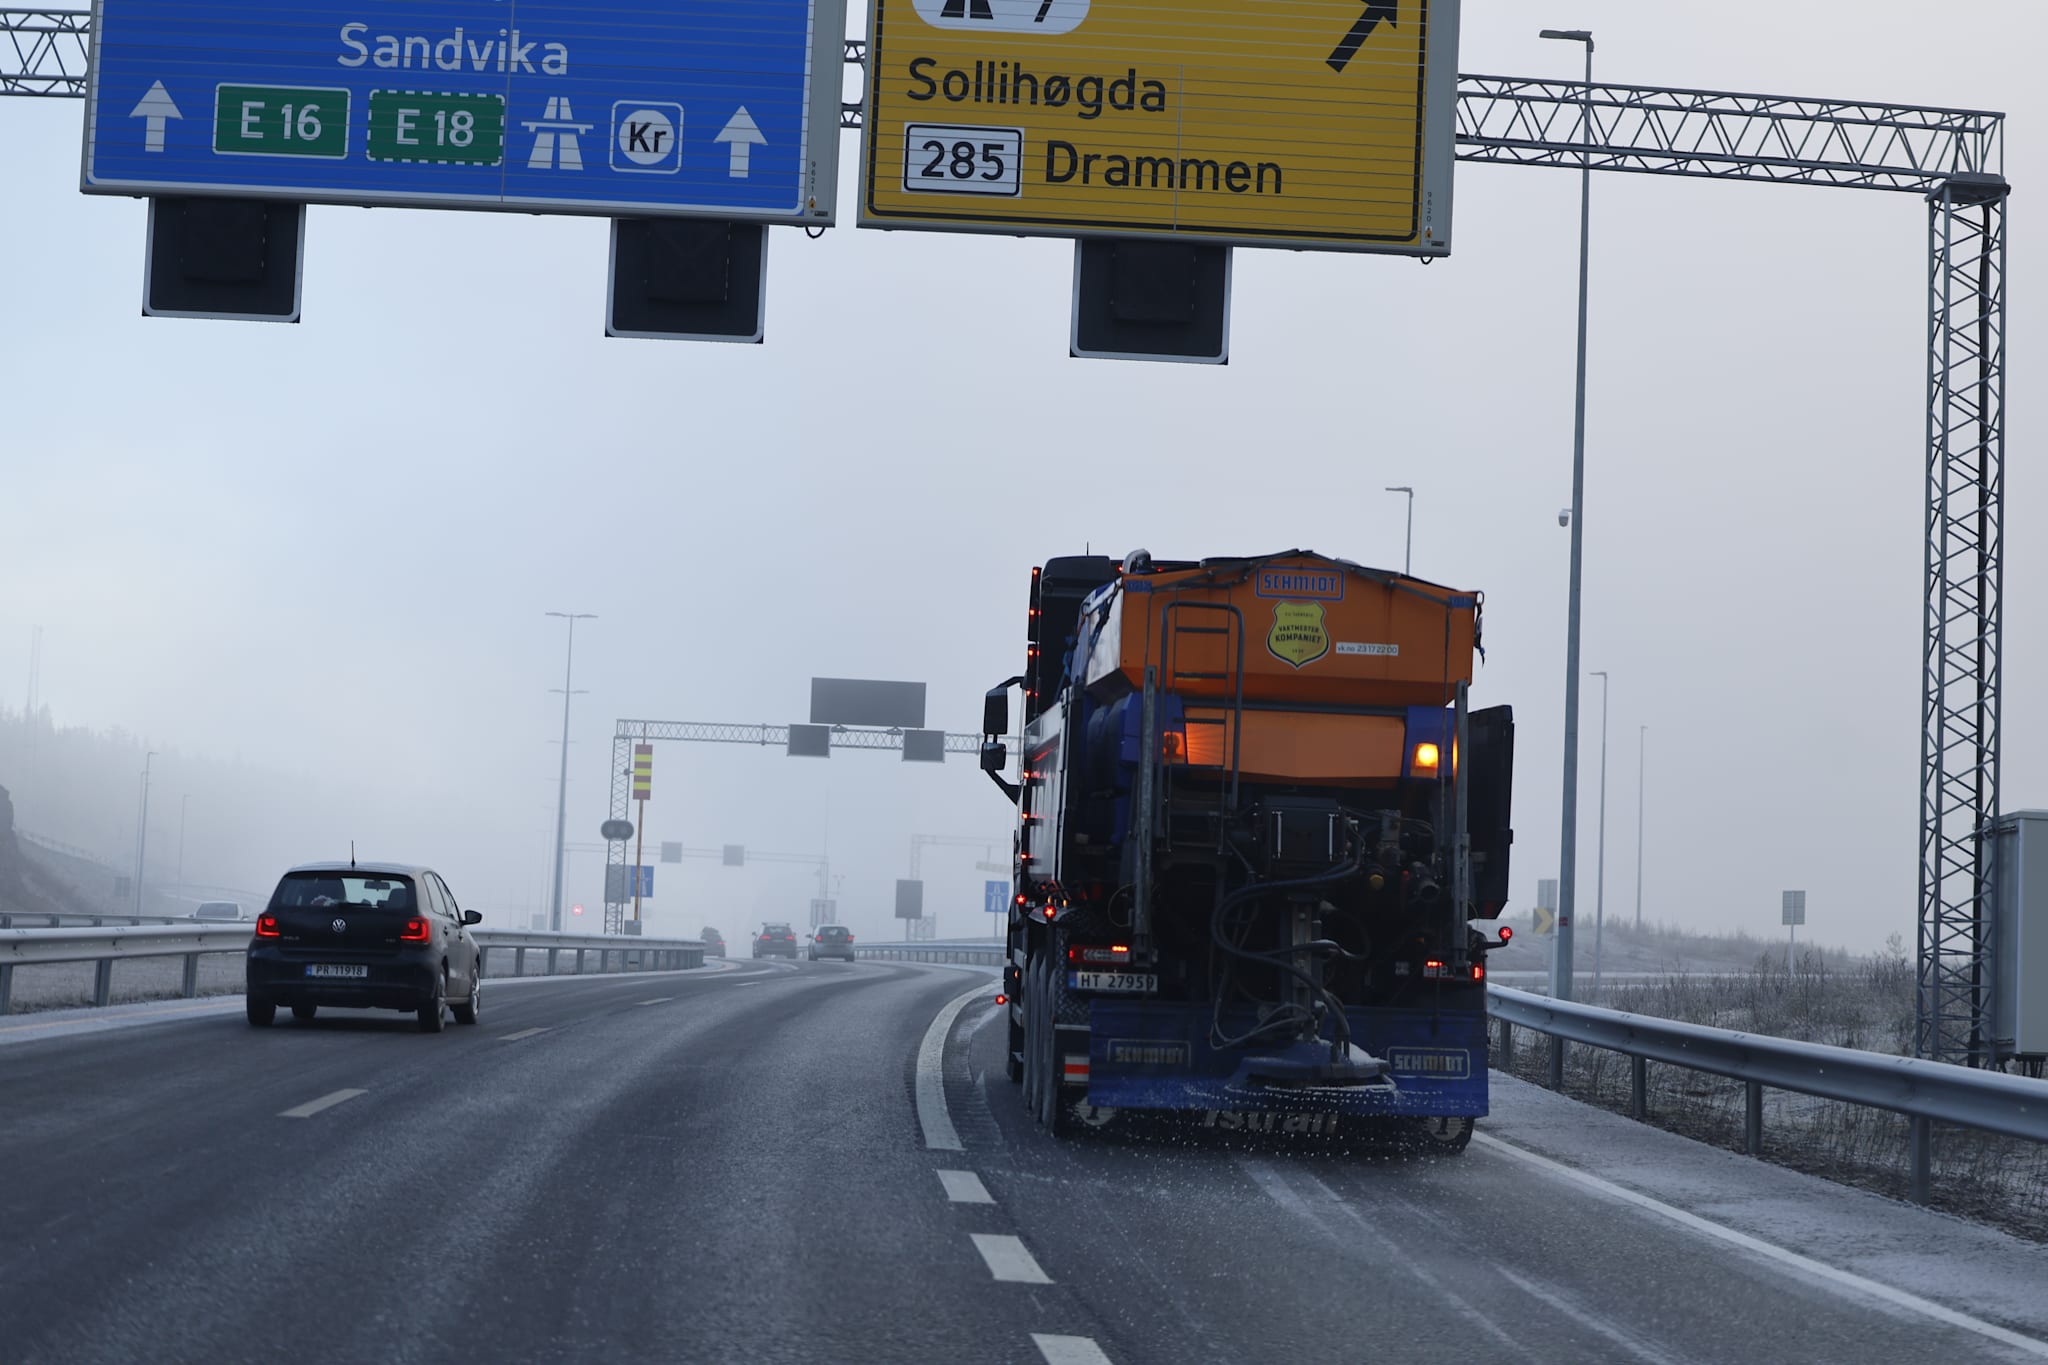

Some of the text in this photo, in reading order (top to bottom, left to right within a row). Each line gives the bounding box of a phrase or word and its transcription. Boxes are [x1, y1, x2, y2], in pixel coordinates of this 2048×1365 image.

[337, 22, 569, 75] Sandvika
[906, 57, 1167, 120] Sollihøgda
[240, 101, 323, 141] E 16
[396, 108, 475, 147] E 18
[628, 121, 667, 153] Kr
[920, 140, 1006, 181] 285
[1045, 140, 1283, 194] Drammen
[1263, 574, 1337, 593] SCHMIDT
[1275, 633, 1321, 645] KOMPANIET
[1081, 974, 1100, 988] HT
[1394, 1054, 1464, 1072] SCHMIDT
